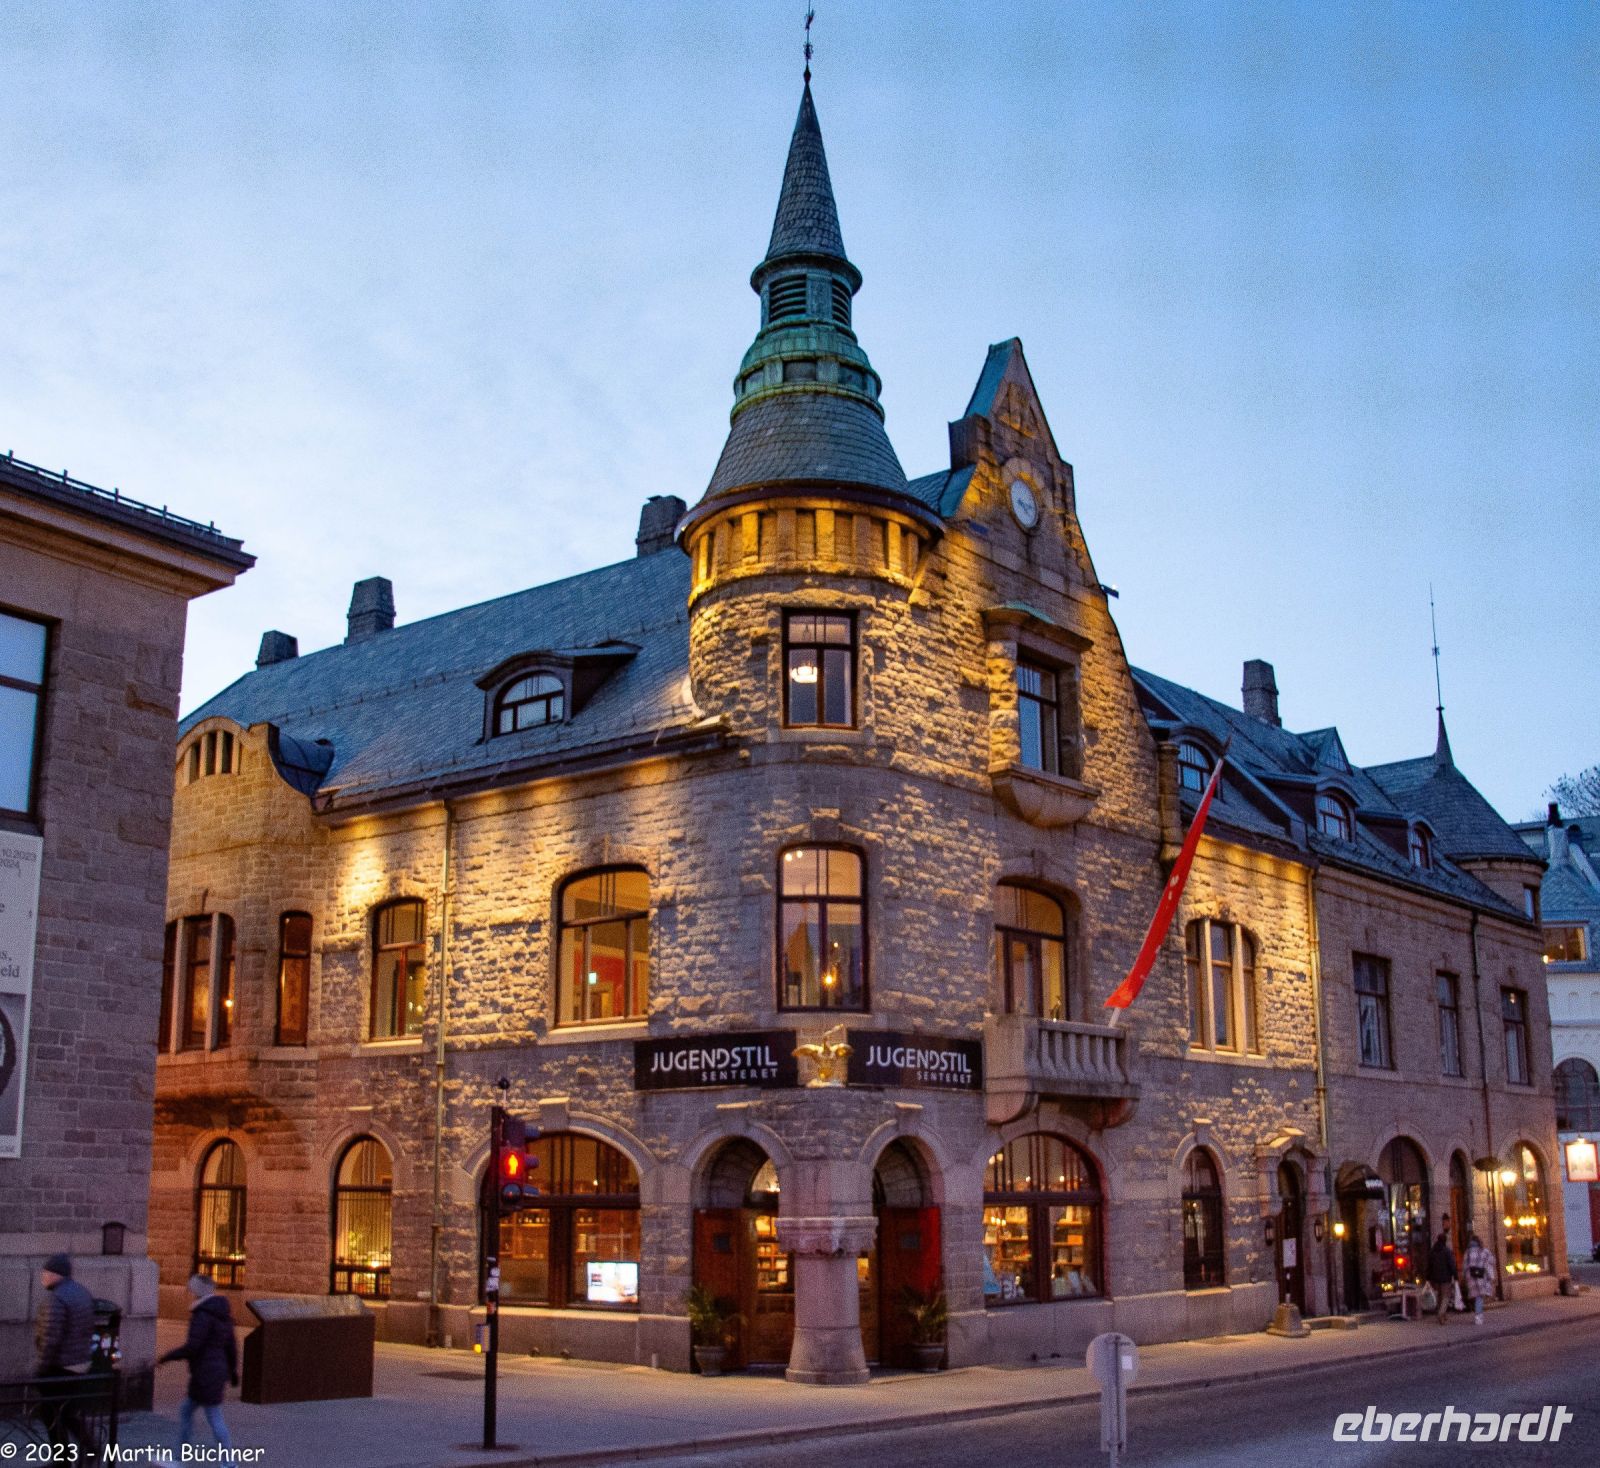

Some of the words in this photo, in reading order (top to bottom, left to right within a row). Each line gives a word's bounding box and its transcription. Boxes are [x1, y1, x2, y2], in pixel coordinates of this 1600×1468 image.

[651, 1045, 778, 1072] JUGENDSTIL
[865, 1045, 972, 1073] JUGENDSTIL
[701, 1068, 778, 1081] SENTERET
[916, 1070, 972, 1083] SENTERET
